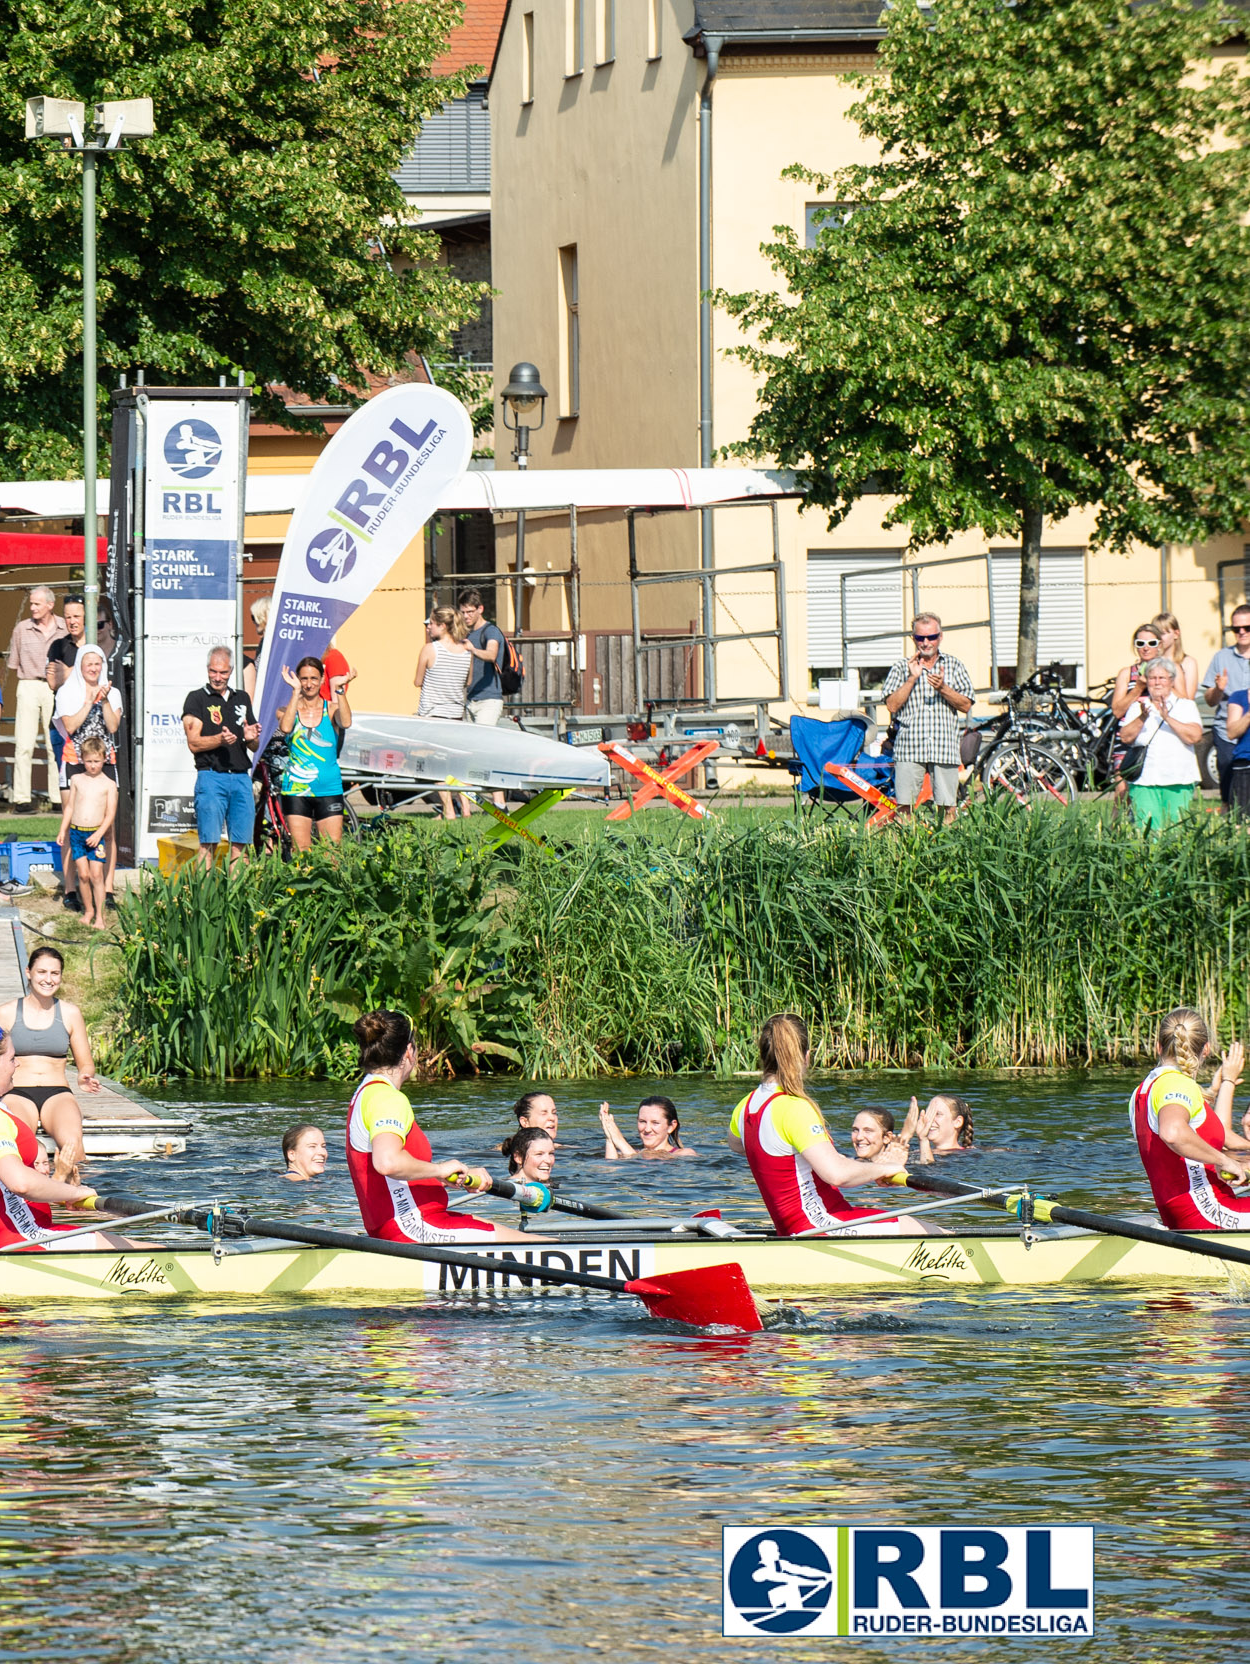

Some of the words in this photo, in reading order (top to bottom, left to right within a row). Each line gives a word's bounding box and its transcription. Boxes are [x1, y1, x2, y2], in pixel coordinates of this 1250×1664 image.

[334, 417, 438, 529] RBL
[366, 428, 447, 535] RUDER-BUNDESLIGA
[162, 492, 222, 514] RBL
[151, 549, 199, 562] STARK.
[151, 563, 215, 577] SCHNELL.
[151, 578, 183, 590] GUT.
[283, 598, 323, 614] STARK.
[280, 612, 332, 630] SCHNELL.
[150, 635, 188, 646] BEST
[192, 635, 229, 646] AUDIT
[278, 627, 304, 641] GUT.
[641, 764, 666, 786] Havel
[666, 782, 692, 805] Queen
[493, 808, 519, 830] Havel
[385, 1118, 405, 1130] RBL
[899, 1240, 969, 1272] Melitta
[100, 1254, 169, 1286] Melitta
[438, 1248, 641, 1291] MINDEN
